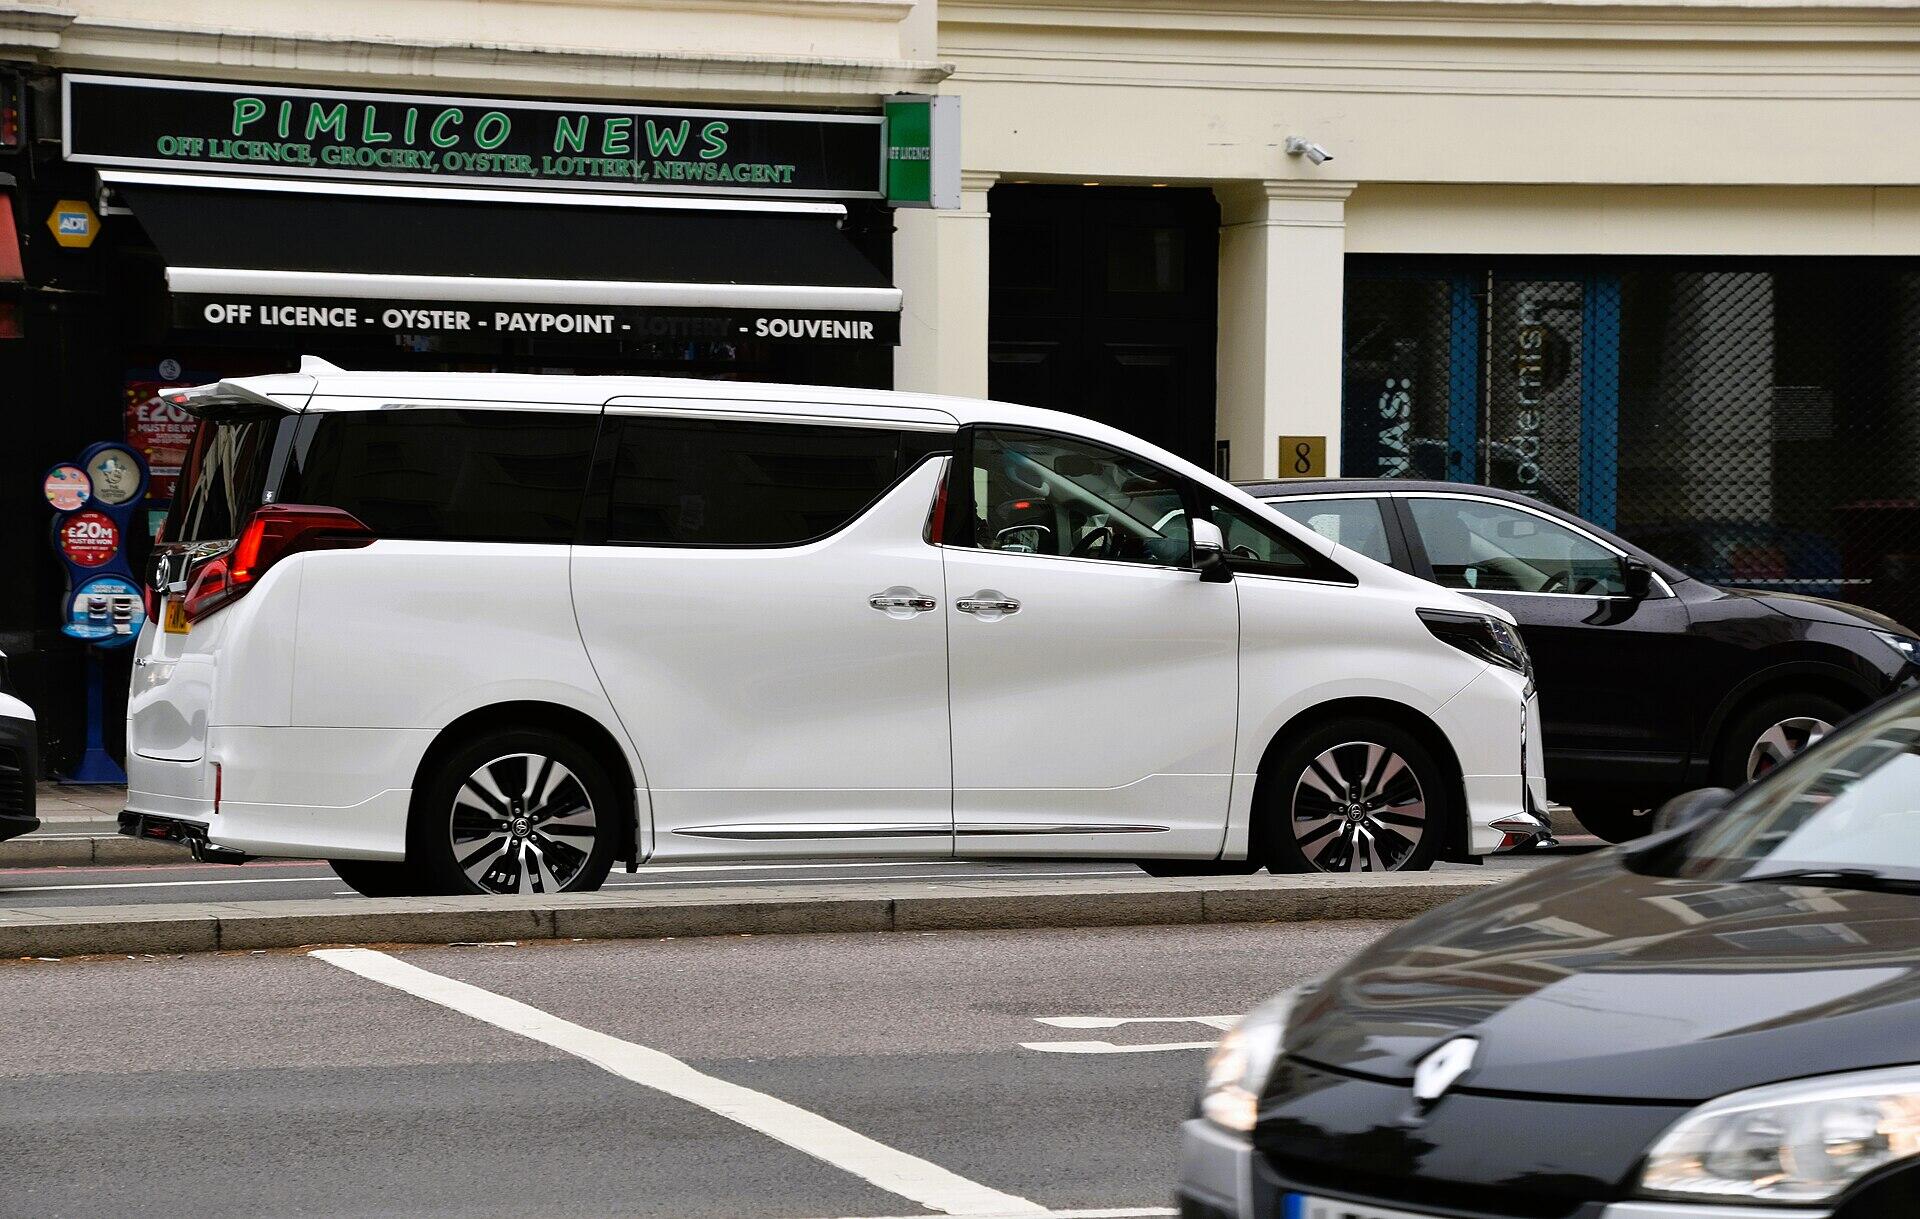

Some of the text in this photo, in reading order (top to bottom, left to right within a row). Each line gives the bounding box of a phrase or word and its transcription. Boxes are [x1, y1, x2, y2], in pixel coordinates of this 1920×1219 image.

[231, 97, 730, 160] PIMLICO NEWS
[157, 135, 796, 184] OFF LICENCE, GROCERY, OYSTER, LOTTERY, NEWSAGENT
[900, 147, 930, 160] LICENCE
[60, 217, 87, 230] ADT
[205, 304, 252, 324] OFF
[261, 305, 357, 328] LICENCE
[382, 309, 471, 330] OYSTER
[495, 312, 615, 334] PAYPOINT
[640, 316, 732, 336] LOTTERY
[755, 318, 874, 340] SOUVENIR
[1507, 288, 1543, 495] odernism
[138, 397, 194, 423] £20
[138, 424, 166, 432] MUST
[1295, 443, 1310, 473] 8
[68, 521, 113, 538] £20M
